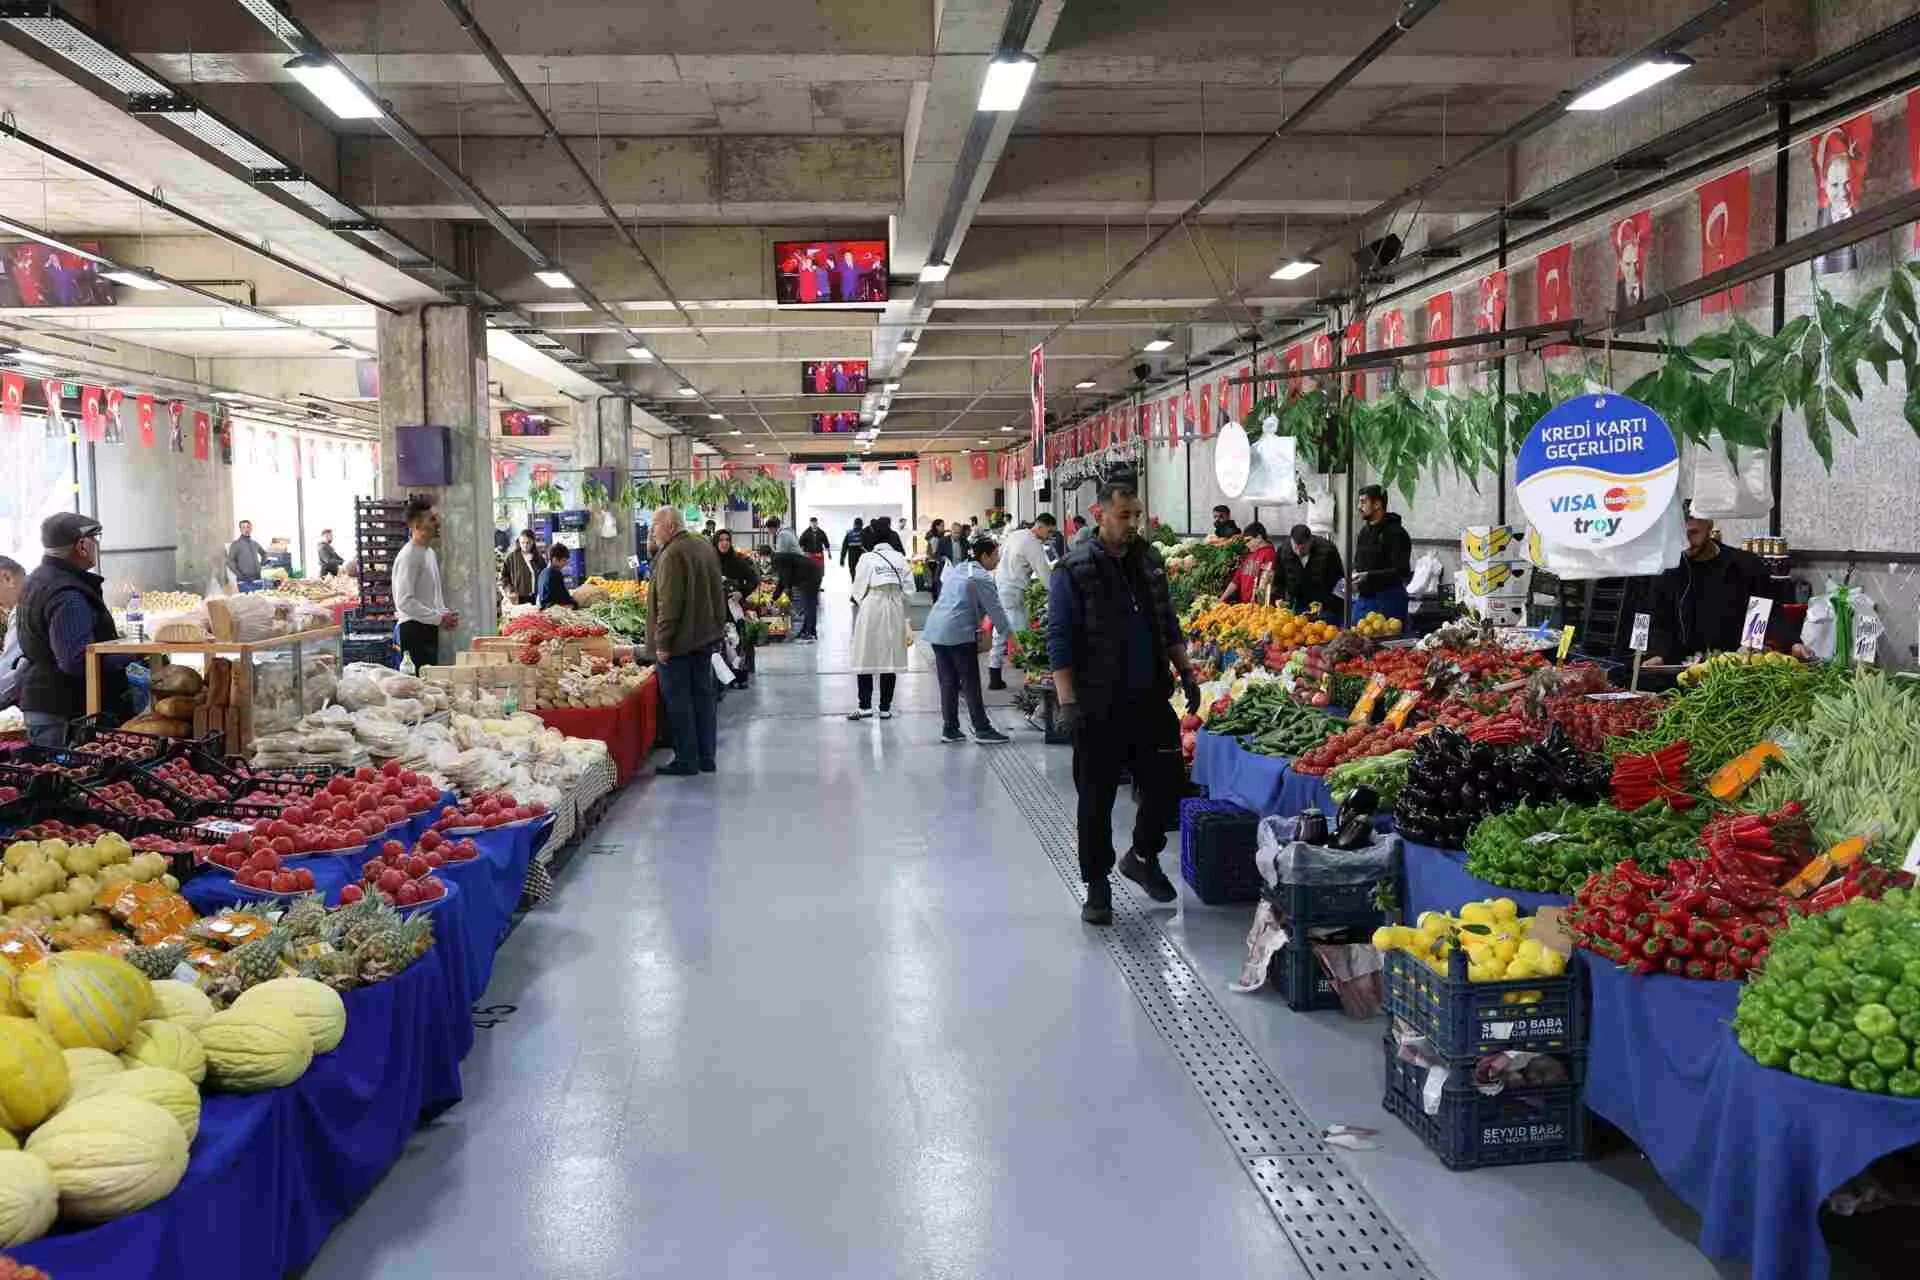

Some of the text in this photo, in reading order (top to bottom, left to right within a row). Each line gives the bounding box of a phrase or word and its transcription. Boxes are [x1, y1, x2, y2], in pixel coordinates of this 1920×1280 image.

[1541, 418, 1647, 443] KREDİ KARTI
[1545, 434, 1644, 460] GEÇERLİDİR
[1550, 494, 1597, 513] VISA
[1574, 517, 1622, 537] troy
[1530, 1018, 1563, 1029] BABA
[1530, 1124, 1562, 1136] BABA
